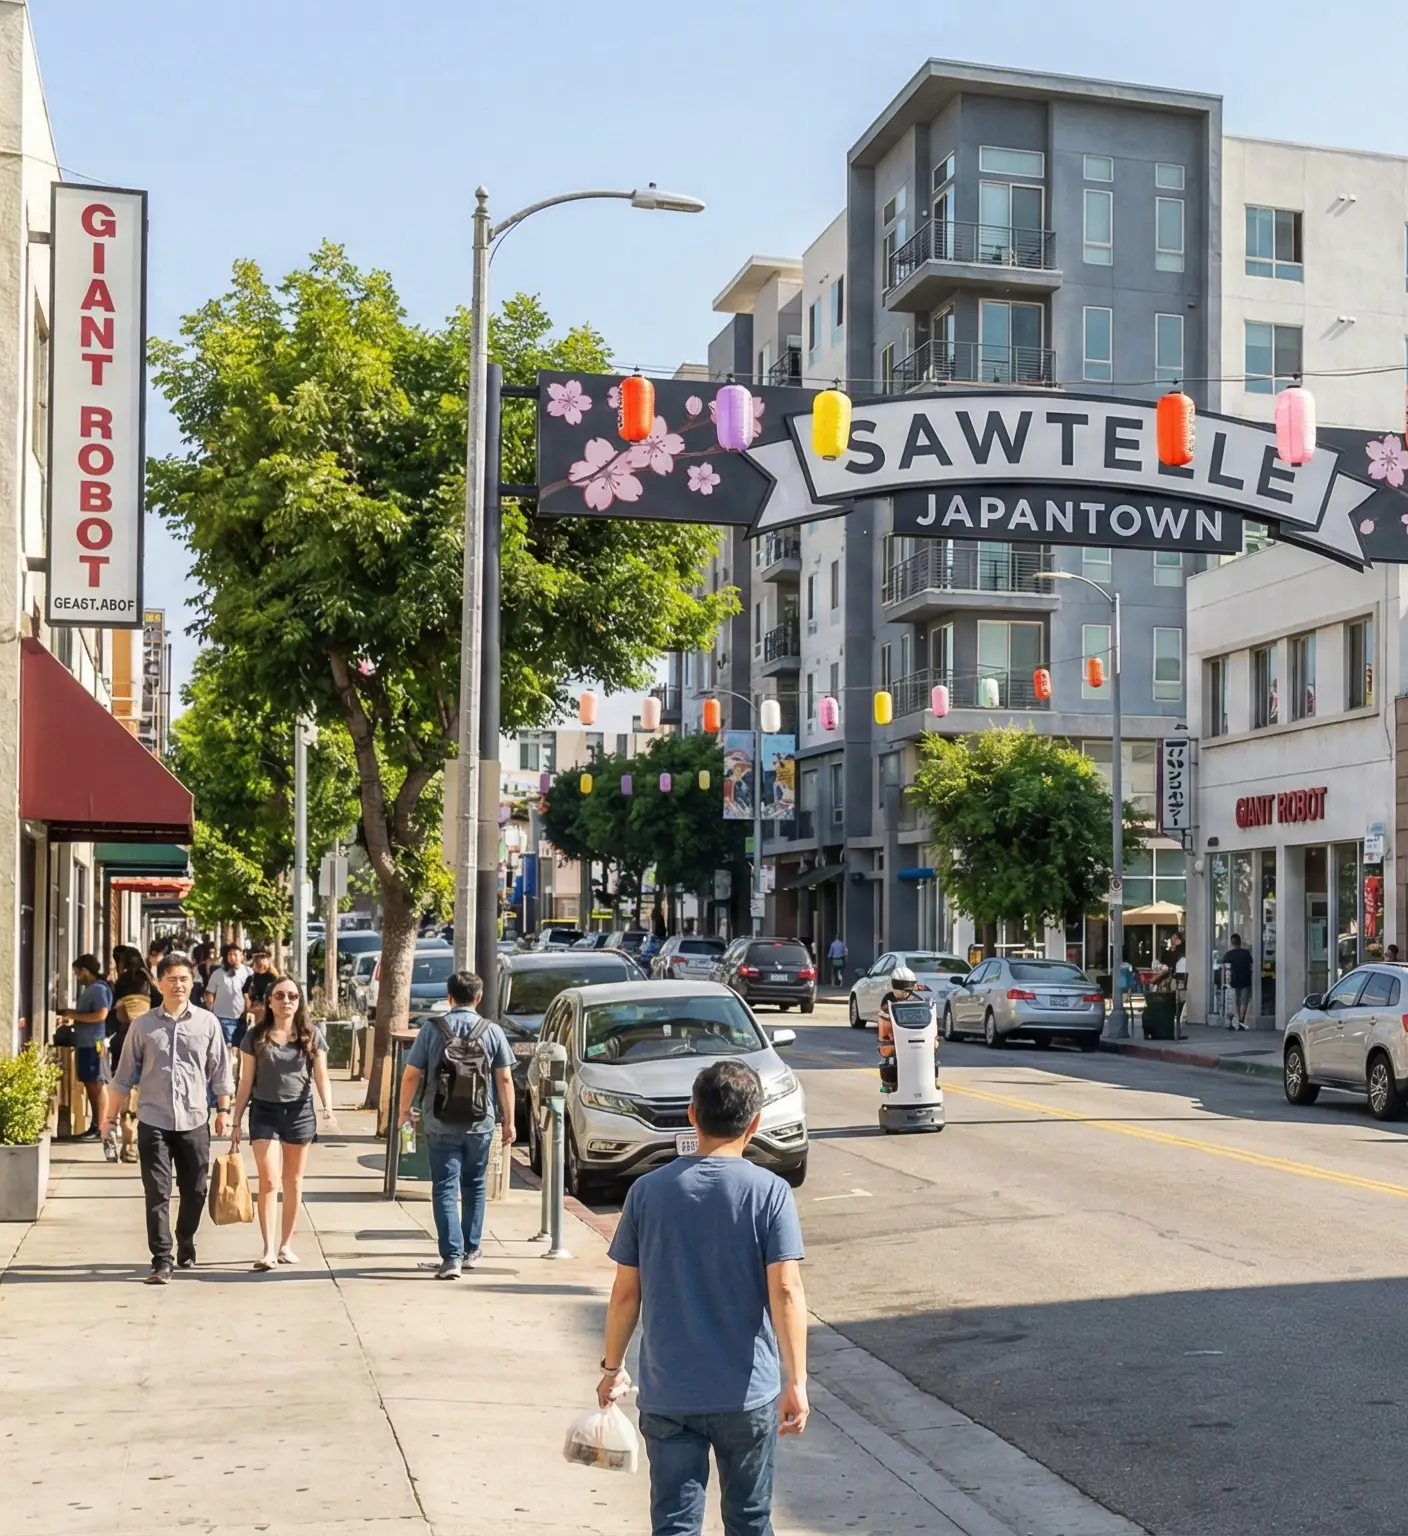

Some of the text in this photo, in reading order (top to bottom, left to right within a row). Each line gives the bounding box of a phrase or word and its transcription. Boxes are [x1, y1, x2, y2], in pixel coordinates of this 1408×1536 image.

[76, 203, 116, 588] GIANT ROBOT
[916, 494, 1222, 542] JAPANTOWN
[1236, 787, 1328, 828] GIANT ROBOT
